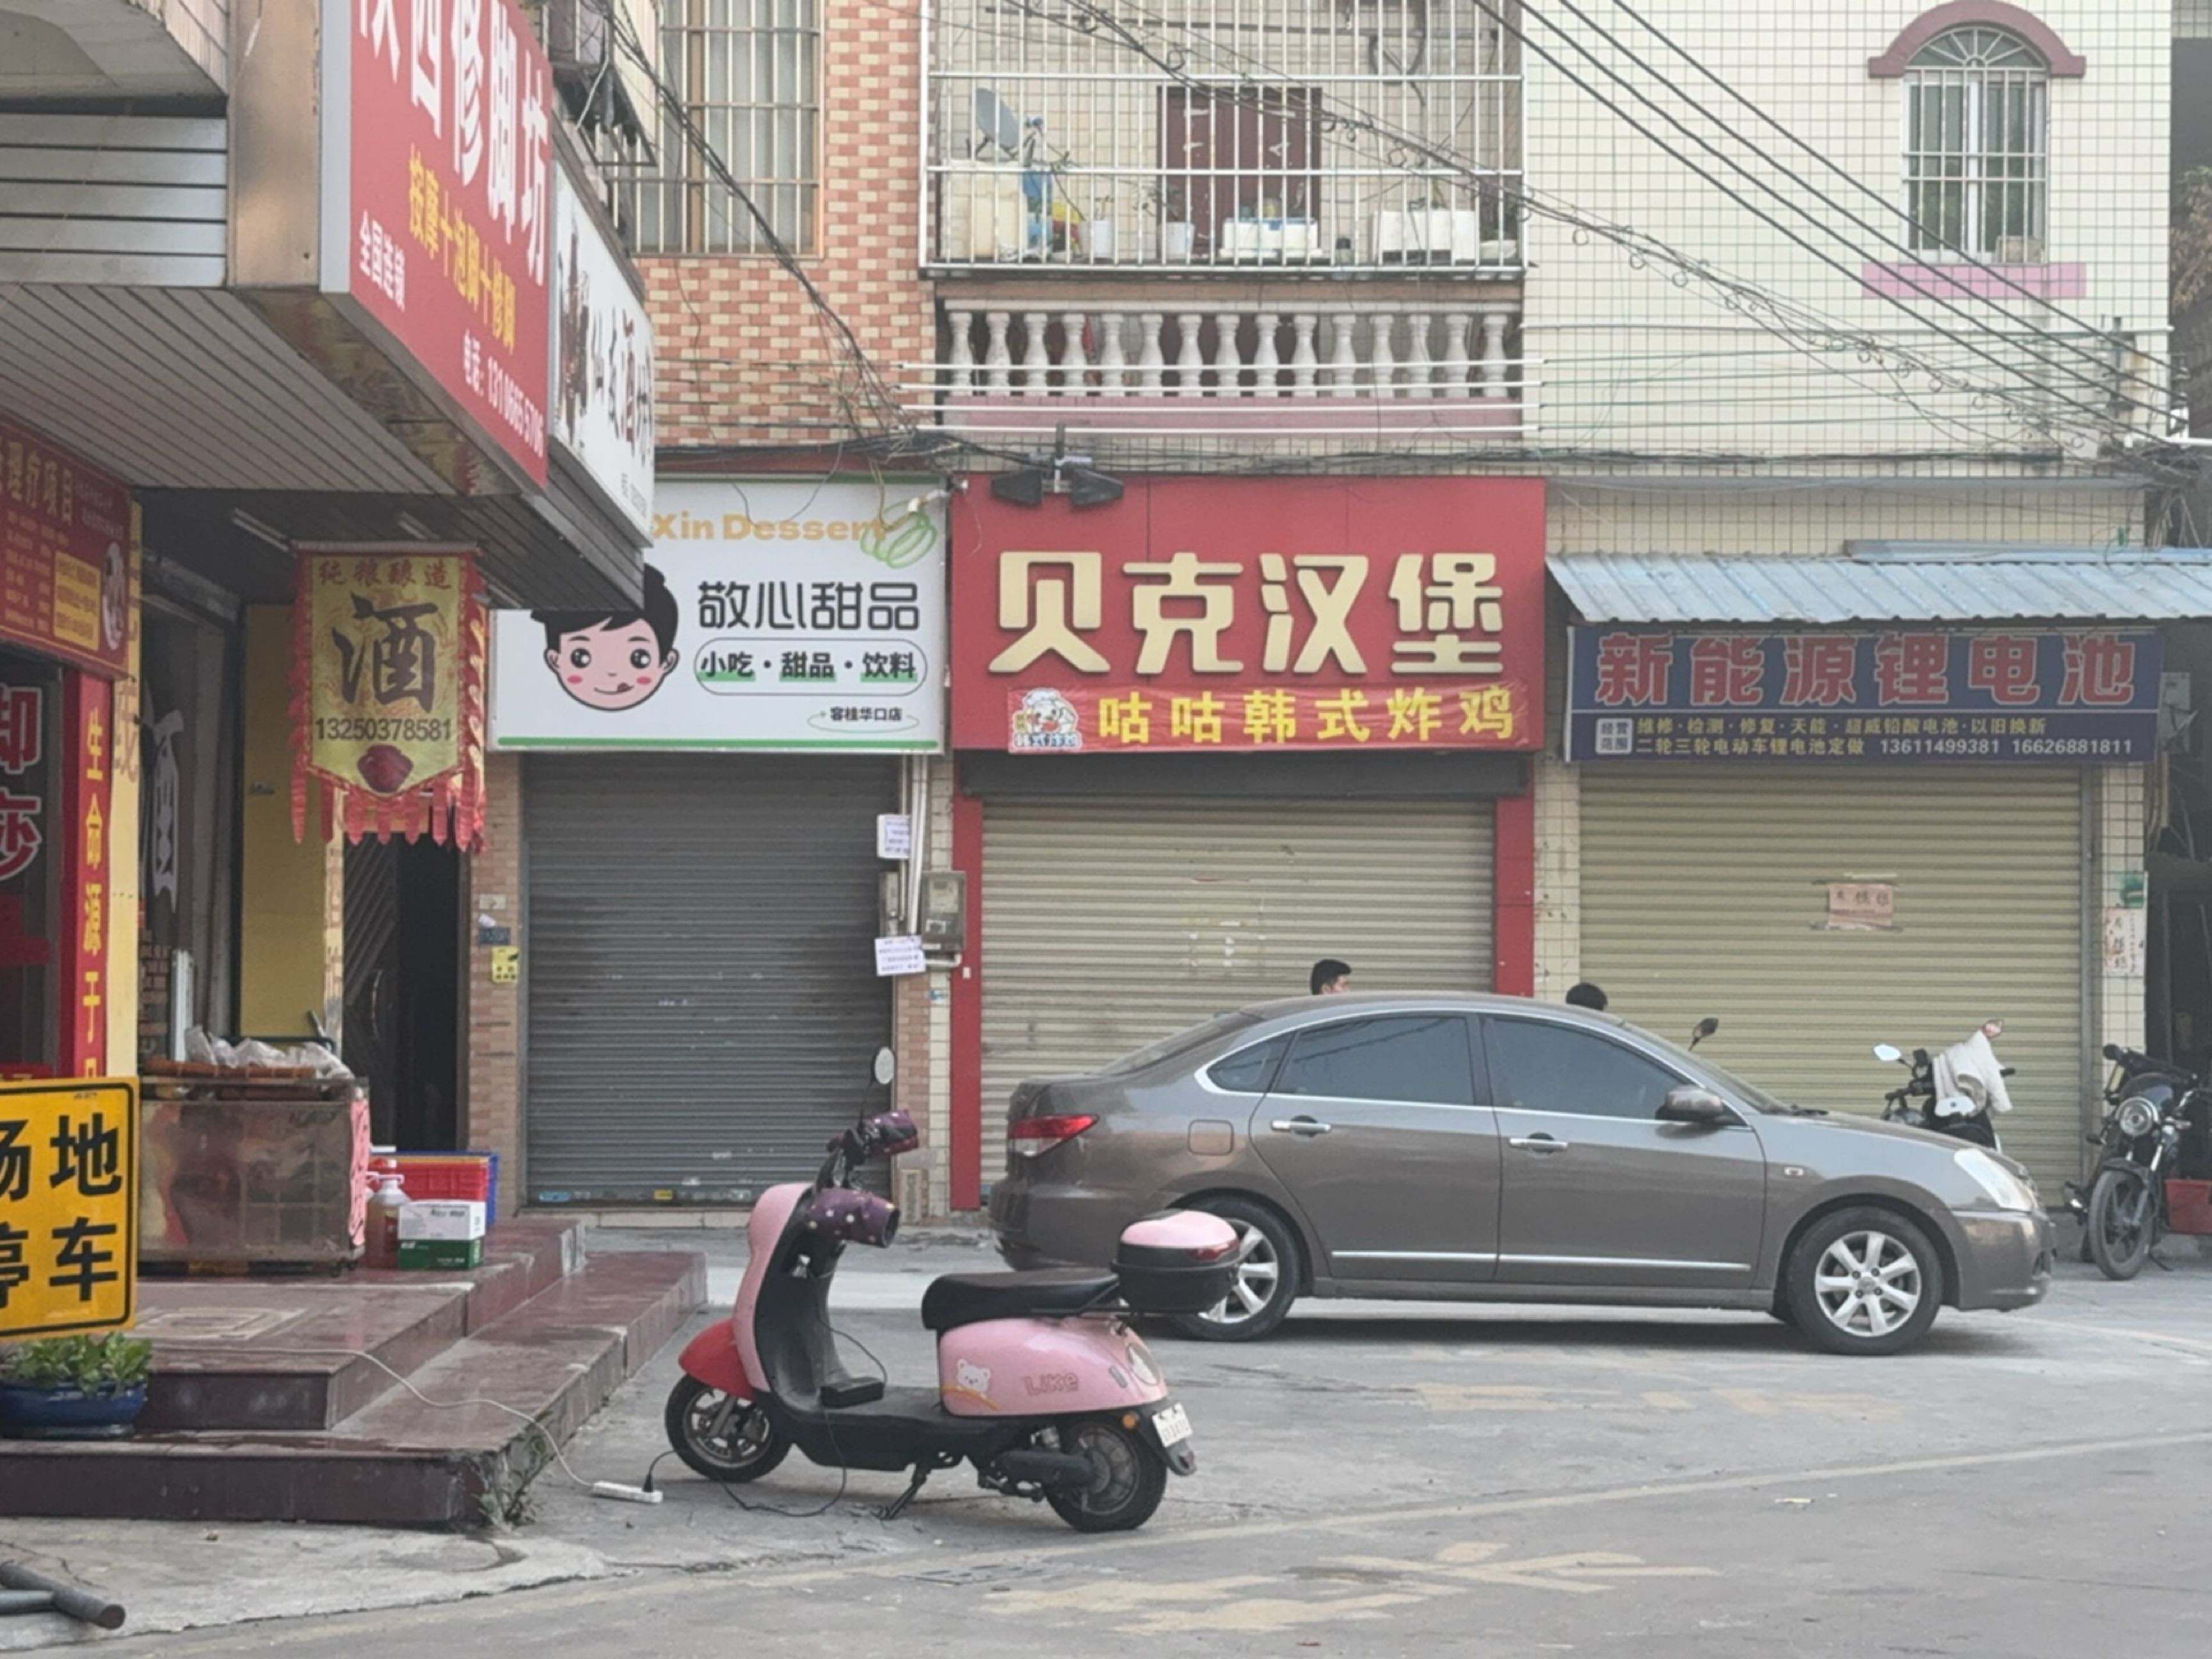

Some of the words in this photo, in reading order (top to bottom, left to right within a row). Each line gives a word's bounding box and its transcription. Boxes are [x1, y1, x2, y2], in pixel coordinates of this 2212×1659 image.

[652, 512, 714, 541] Xin
[698, 581, 920, 630] 敬心甜品
[988, 550, 1504, 675] 贝克汉堡
[332, 590, 440, 714] 酒
[1594, 632, 2135, 707] 新能源锂电池
[316, 717, 452, 742] 13250378581
[830, 706, 902, 721] 容桂华口店
[1098, 686, 1514, 743] 咕咕韩式炸鸡
[1880, 738, 2000, 755] 13611499381
[2013, 737, 2133, 755] 16626881811
[83, 707, 103, 1077] 生命源于
